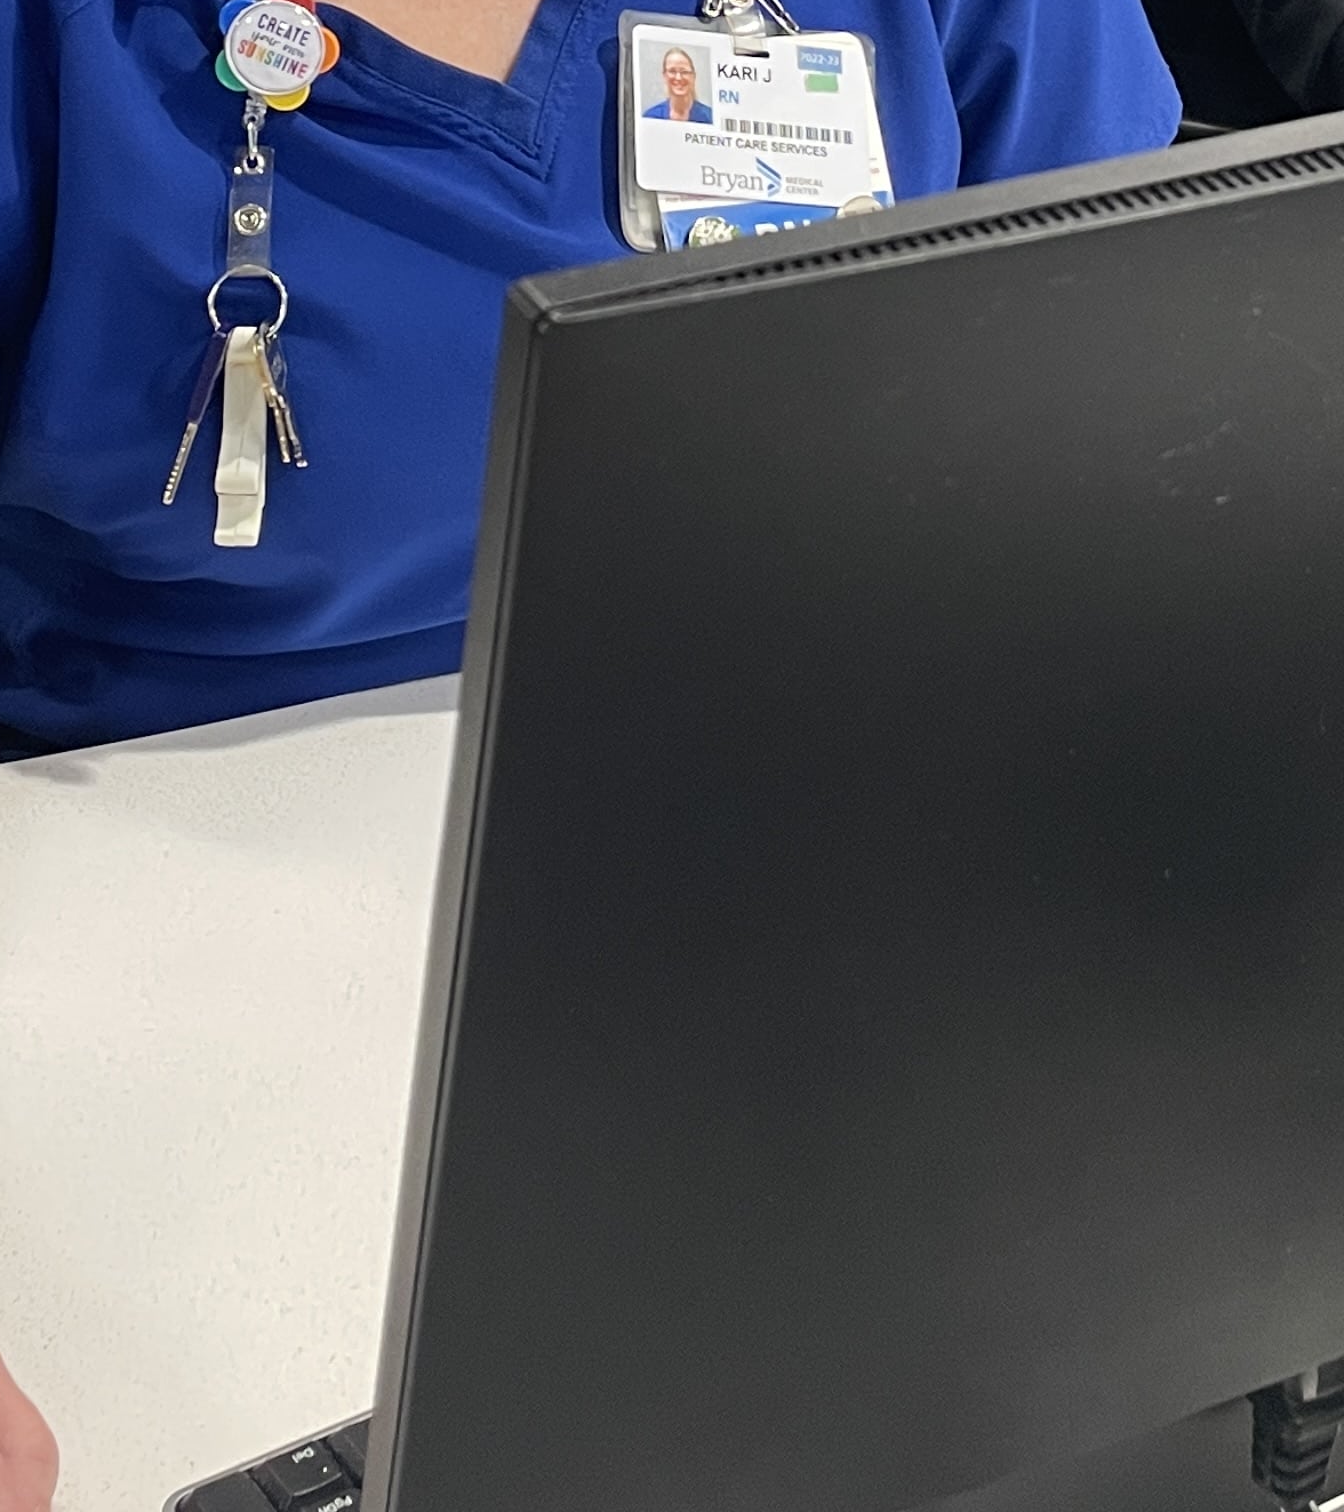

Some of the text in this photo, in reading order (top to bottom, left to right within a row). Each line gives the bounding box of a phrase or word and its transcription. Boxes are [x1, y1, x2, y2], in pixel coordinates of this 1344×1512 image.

[258, 13, 311, 47] CREATE
[237, 39, 309, 79] SUNSHINE
[717, 63, 772, 84] KARI J
[718, 89, 740, 105] RN
[684, 132, 828, 158] PATIENT CARE SERVICES
[700, 164, 764, 193] Bryan
[785, 176, 824, 188] MEDICAL
